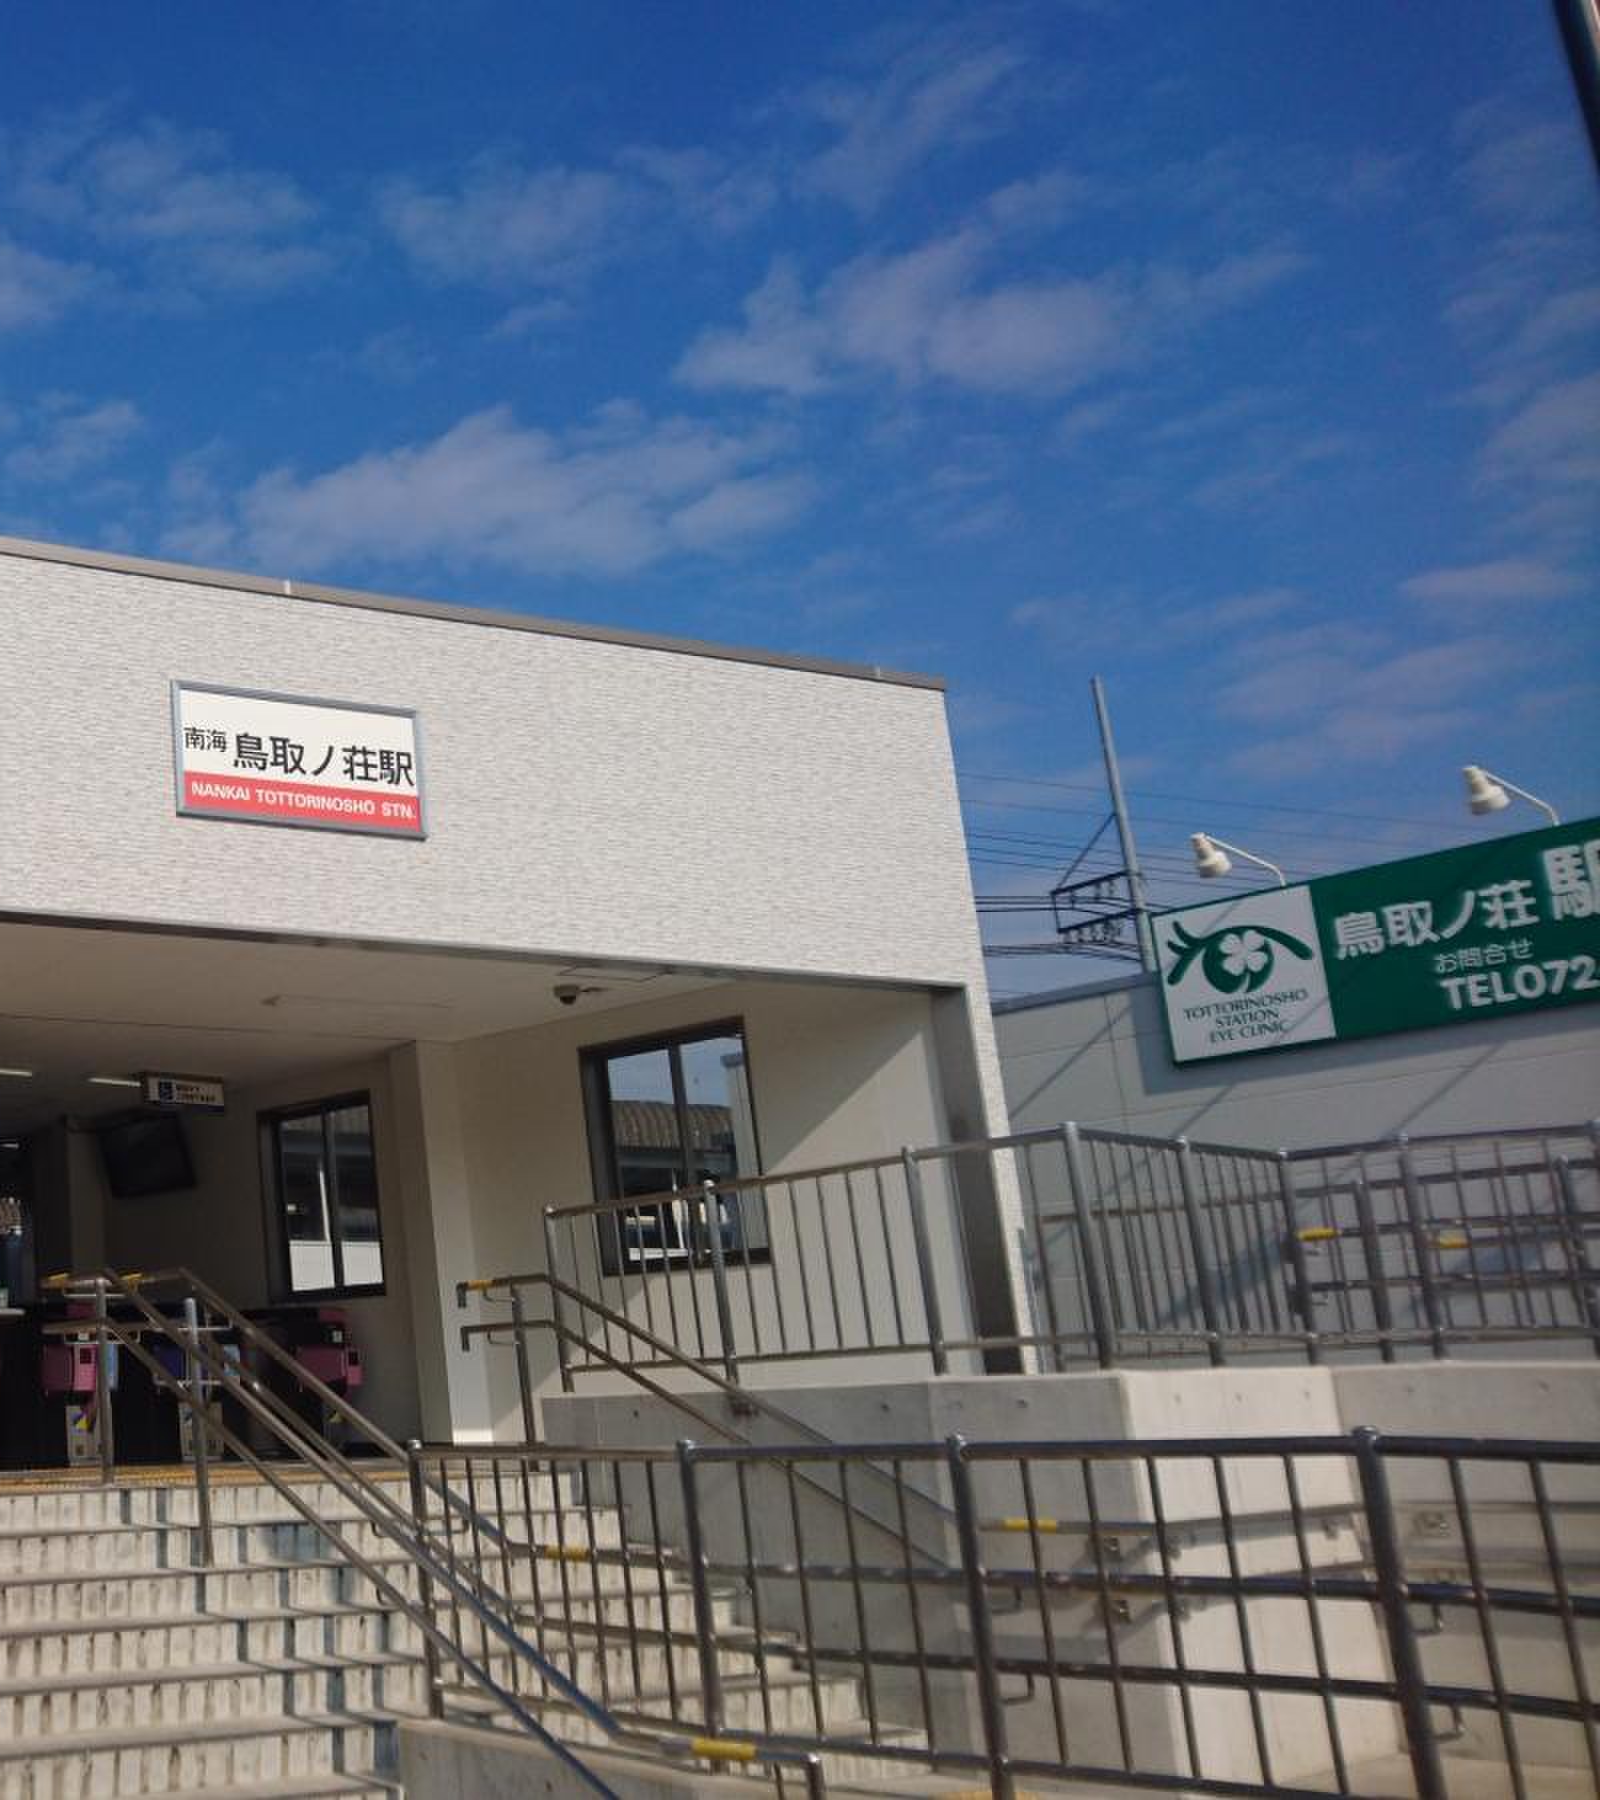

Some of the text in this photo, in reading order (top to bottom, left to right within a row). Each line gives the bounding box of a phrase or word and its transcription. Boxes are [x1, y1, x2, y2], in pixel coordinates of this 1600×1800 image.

[184, 726, 415, 787] 南海 鳥取ノ荘駅
[191, 781, 416, 820] NANKAI TOTTORINOSHO STN.
[1434, 937, 1534, 973] お問合せ
[1183, 989, 1309, 1021] TOTTORINOSHO
[1215, 1009, 1279, 1028] STATION
[1210, 1020, 1290, 1044] EYE CLINIC
